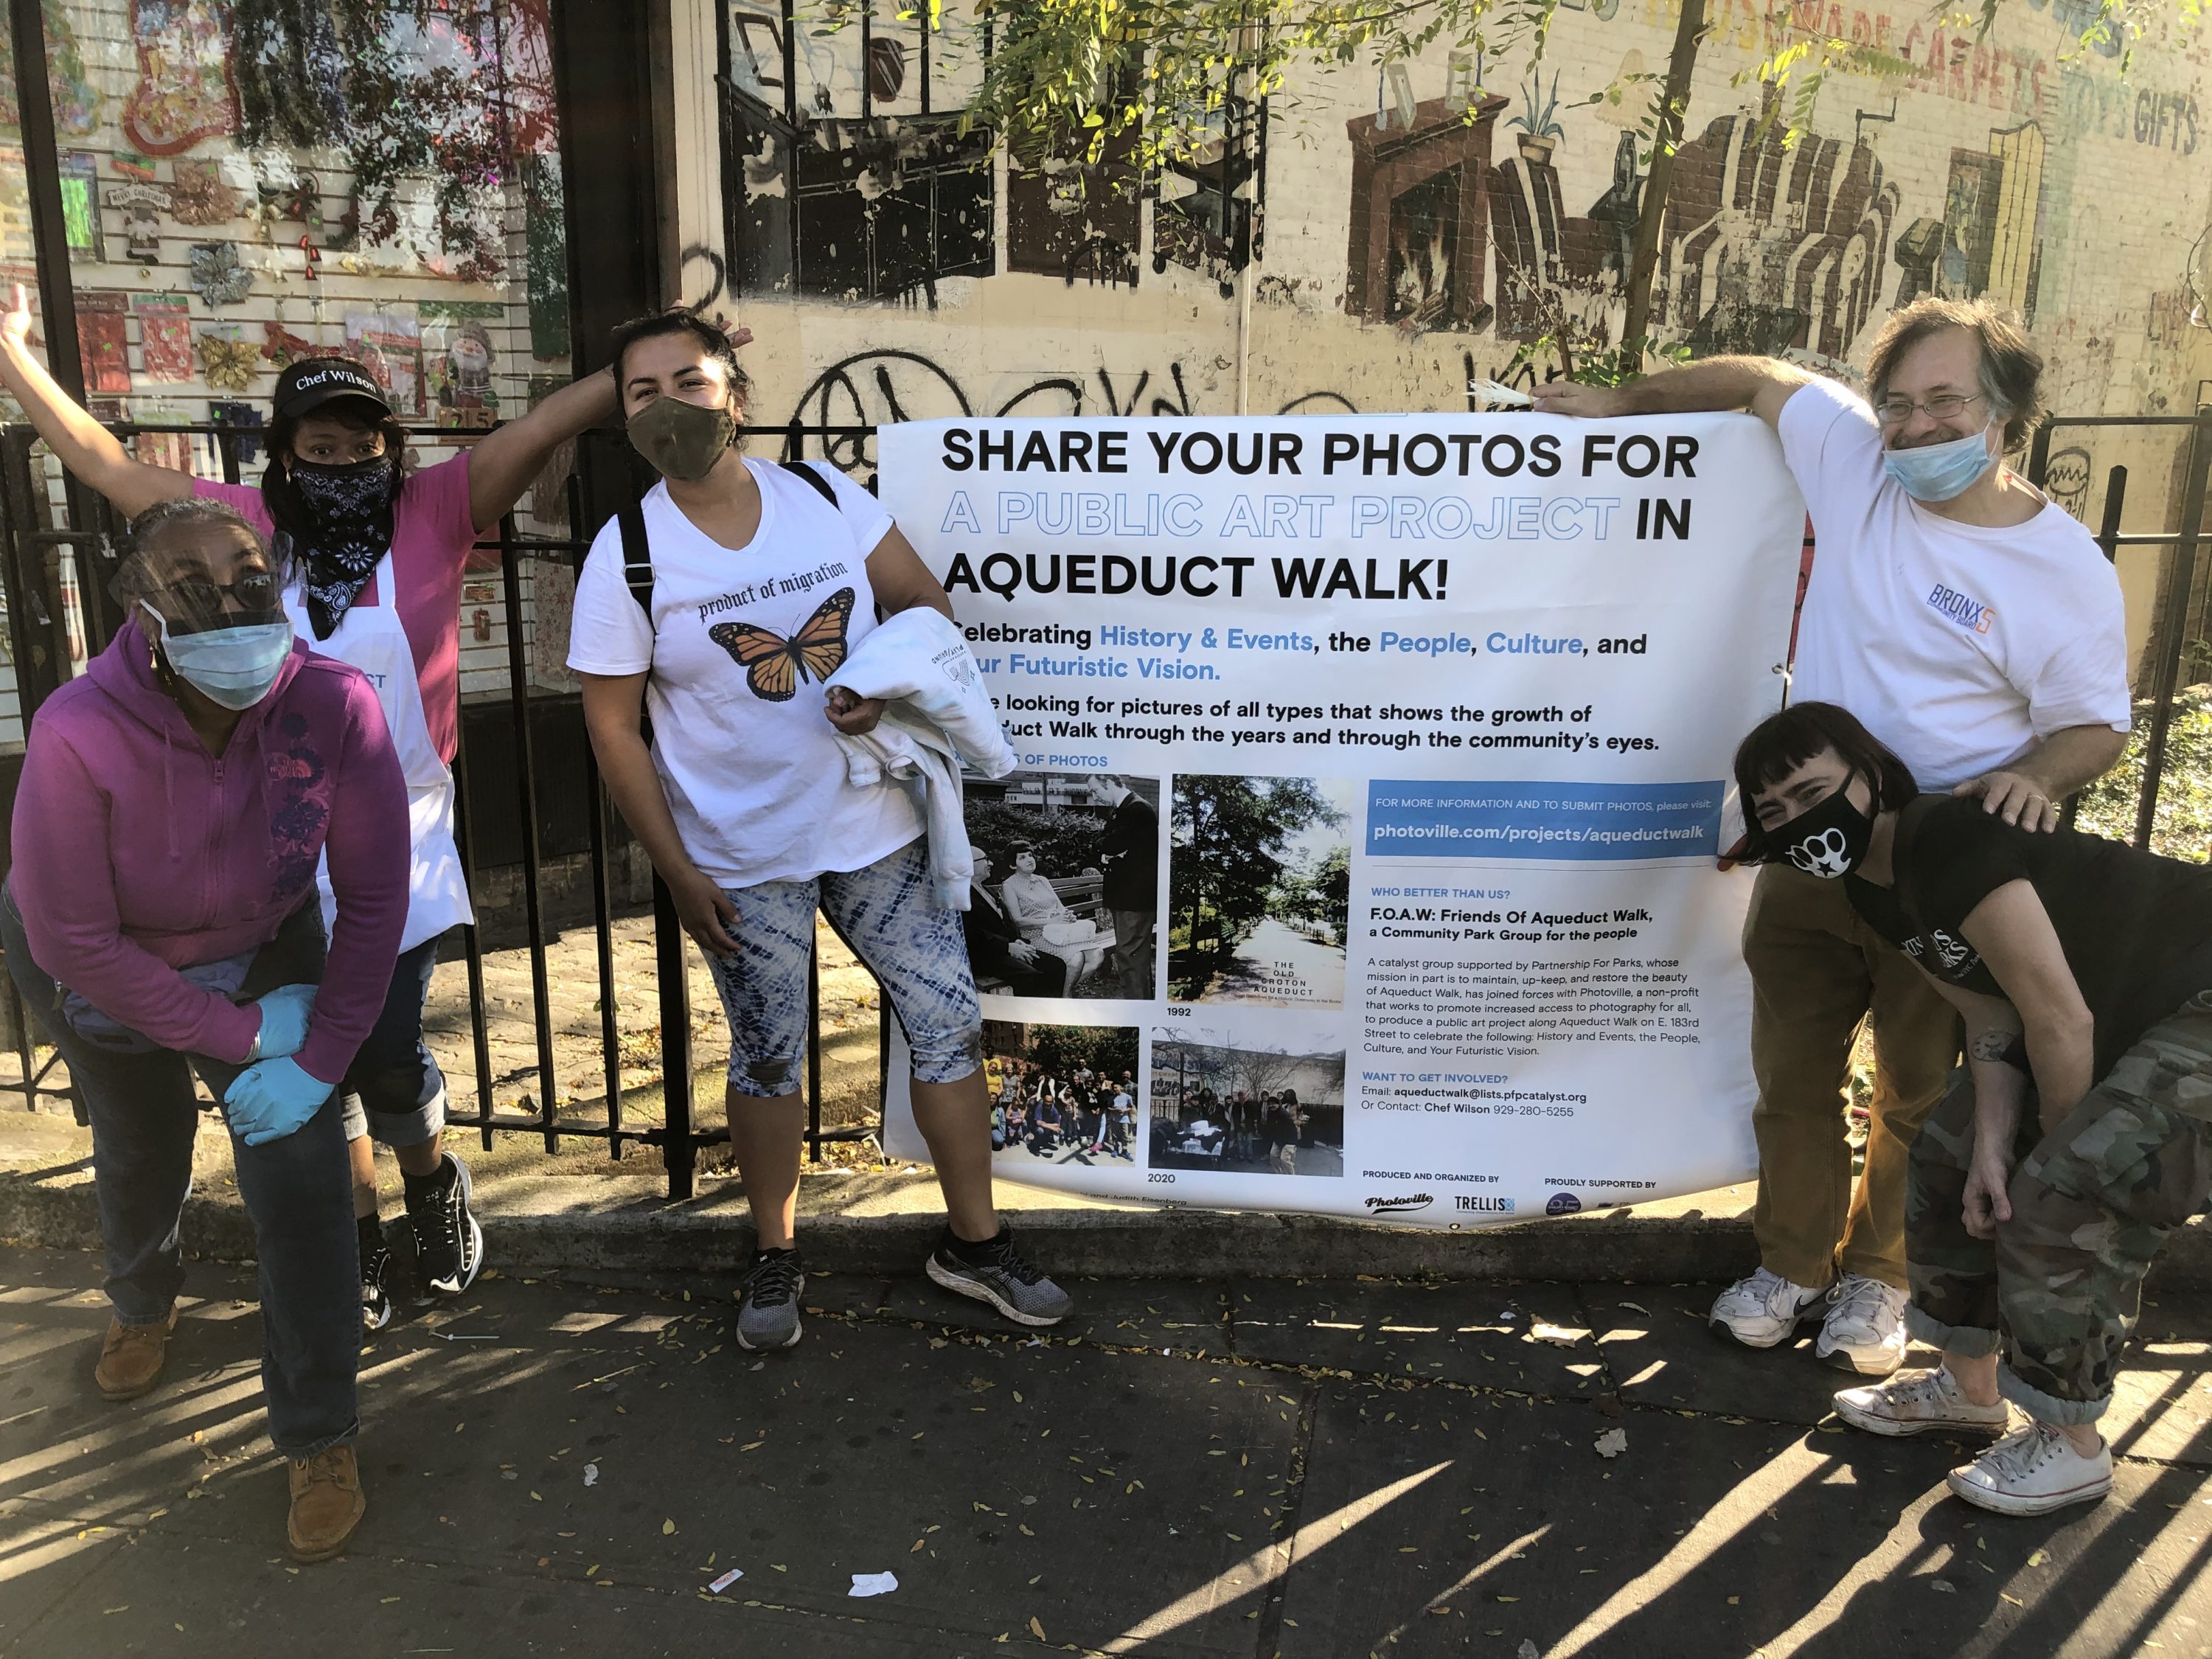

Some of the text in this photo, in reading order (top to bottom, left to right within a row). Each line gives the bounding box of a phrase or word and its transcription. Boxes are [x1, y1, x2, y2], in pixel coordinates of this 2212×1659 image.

[2134, 88, 2199, 156] GIFTS
[296, 370, 378, 394] Chef Wilson
[942, 428, 1699, 478] SHARE YOUR PHOTOS FOR
[941, 491, 1691, 540] A PUBLIC ART PROJECT IN
[945, 553, 1447, 602] AQUEDUCT WALK!
[698, 562, 849, 625] product of migration
[1956, 616, 1977, 630] BOARD
[1102, 626, 1192, 652] History
[1201, 628, 1217, 648] &
[1228, 629, 1319, 655] Events,
[1329, 631, 1370, 652] the
[1381, 633, 1476, 657] People,
[1487, 633, 1588, 658] Culture,
[1598, 634, 1646, 654] and
[1010, 654, 1128, 677] Futuristic
[1137, 658, 1220, 680] Vision.
[1007, 695, 1079, 716] looking
[1086, 696, 1115, 712] for
[1122, 698, 1203, 717] pictures
[1210, 700, 1230, 717] of
[1237, 702, 1259, 717] all
[1267, 703, 1323, 722] types
[1330, 703, 1371, 719] that
[1379, 704, 1442, 720] shows
[1450, 706, 1484, 722] the
[1492, 706, 1562, 726] growth
[1571, 705, 1592, 722] of
[1049, 721, 1097, 737] Walk
[1105, 723, 1184, 744] through
[1192, 726, 1224, 742] the
[1231, 731, 1285, 746] years
[1293, 728, 1330, 744] and
[1338, 728, 1420, 751] through
[1428, 731, 1461, 747] the
[1469, 731, 1599, 752] community's
[1607, 737, 1658, 754] eyes.
[1025, 754, 1107, 767] OF PHOTOS
[1376, 799, 1711, 813] FOR MORE INFORMATION AND TO SUBMIT PHOTOS, please visit:
[1374, 824, 1703, 845] photoville.com/projects/aqueductwalk
[1371, 888, 1510, 899] WHO BETTER THAN US?
[1371, 908, 1652, 926] F.O.A.W: Friends Of Aqueduct Walk,
[1382, 927, 1460, 941] Community
[1464, 929, 1495, 939] Park
[1500, 930, 1542, 943] Group
[1546, 931, 1565, 941] for
[1569, 931, 1590, 940] the
[1594, 928, 1637, 942] people
[1368, 958, 1678, 972] A catalyst group supported by Partnership For Parks, whose
[1273, 970, 1294, 978] OLD
[1254, 987, 1313, 996] AQUEDUCT
[1366, 987, 1377, 995] of
[1380, 987, 1432, 998] Aqueduct
[1436, 989, 1461, 998] Walk,
[1466, 990, 1484, 998] has
[1486, 990, 1519, 1000] joined
[1522, 990, 1554, 998] forces
[1557, 989, 1576, 997] with
[1581, 988, 1632, 997] Photoville,
[1646, 987, 1699, 998] non-profit
[1166, 1007, 1191, 1017] 1992
[1364, 1043, 1539, 1055] Culture, and Your Futuristic Vision.
[1363, 1072, 1508, 1083] WANT TO GET INVOLVED?
[1363, 1086, 1586, 1104] Email: aqueductwalk@lists.pfpcatalyst.org
[1361, 1100, 1573, 1116] Or Contact: Chef Wilson 929-280-5255
[1147, 1173, 1176, 1183] 2020
[1435, 1174, 1486, 1182] ORGANIZED
[1589, 1180, 1643, 1188] SUPPORTED
[1110, 1194, 1139, 1202] Judith
[1141, 1196, 1188, 1206] Eisenberg
[1365, 1193, 1434, 1210] Photoville
[1454, 1195, 1506, 1211] TRELLIS
